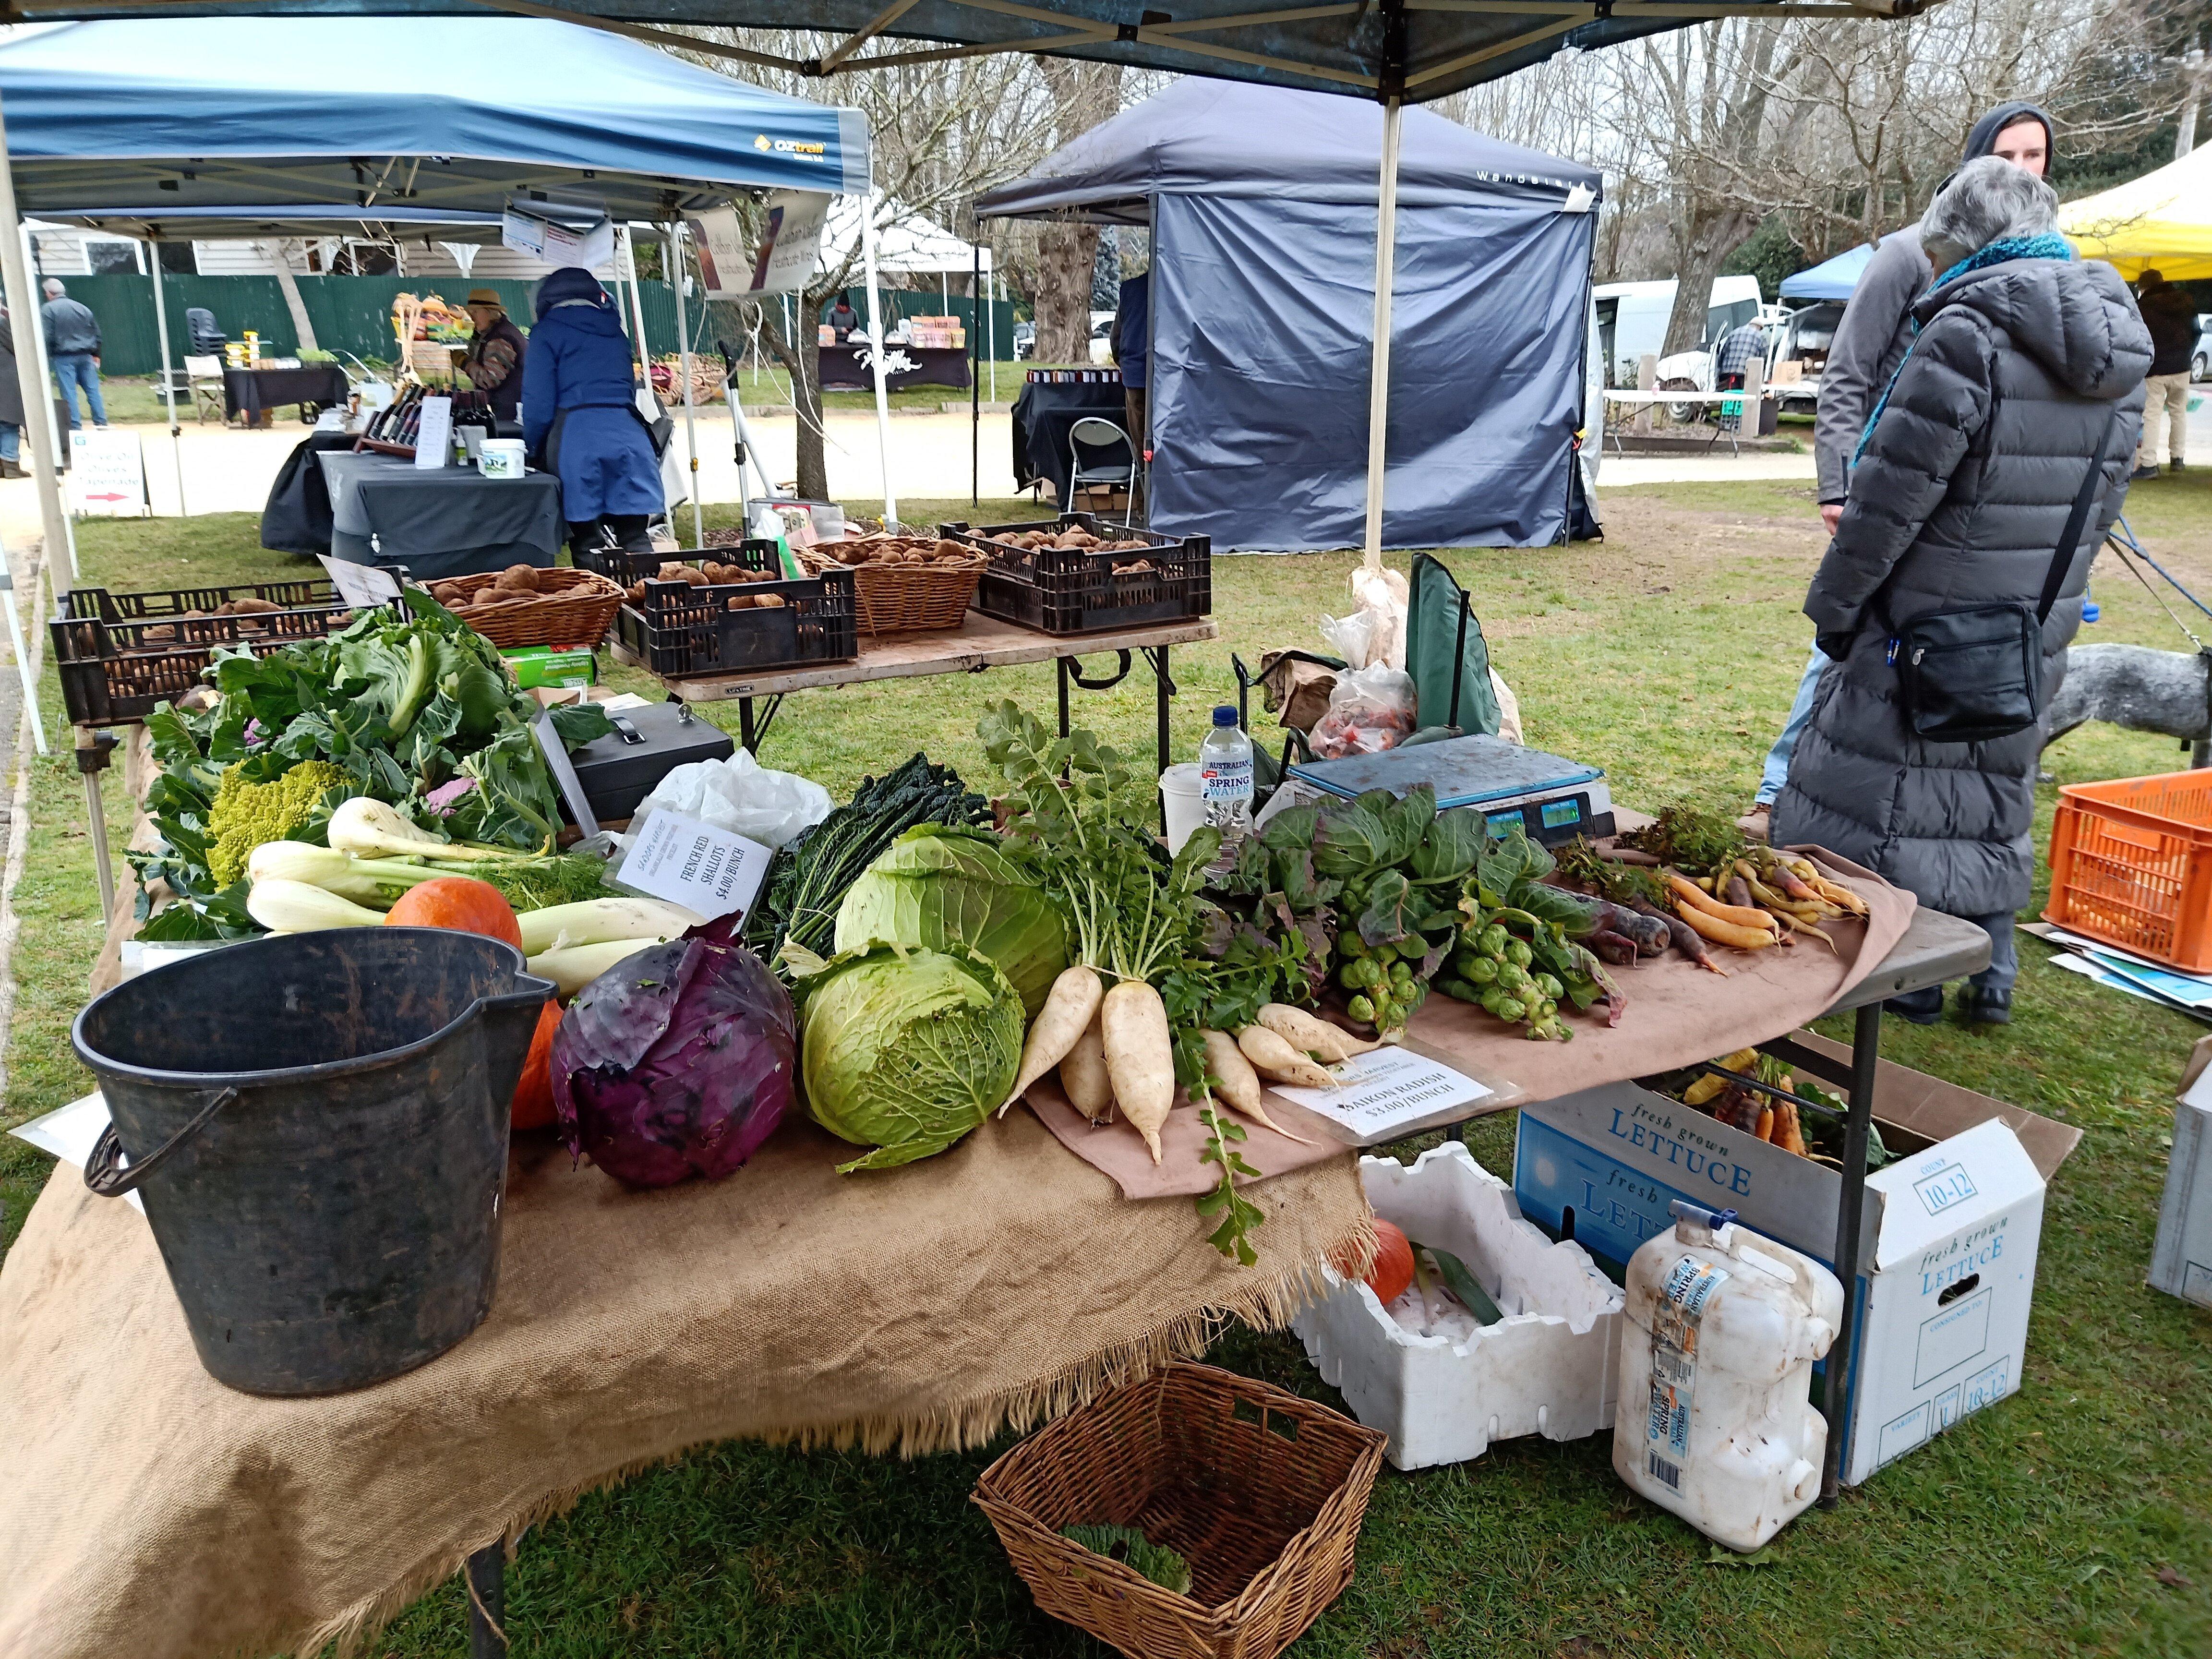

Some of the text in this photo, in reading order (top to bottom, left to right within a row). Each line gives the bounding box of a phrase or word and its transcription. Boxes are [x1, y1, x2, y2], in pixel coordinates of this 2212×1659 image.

[1477, 170, 1572, 189] Wanderer
[1209, 759, 1249, 769] AUSTRALIAN
[1209, 776, 1249, 787] SPRING
[1210, 784, 1249, 796] WATER
[680, 836, 709, 882] FRENCH RED
[701, 845, 725, 885] SHALLOTS
[715, 847, 745, 900] $4.00/BUNCH
[1346, 1089, 1397, 1111] DAIKON
[1395, 1072, 1446, 1094] RADISH
[1365, 1083, 1455, 1118] $3.00/BUNCH
[1631, 1103, 1729, 1157] fresh grown
[1608, 1107, 1751, 1197] LETTUCE
[1920, 1157, 1946, 1175] COUNT
[1606, 1169, 1658, 1203] fresh
[1925, 1173, 1972, 1209] 10-12
[1918, 1216, 2008, 1275] fresh grown
[1922, 1235, 2003, 1295] LETTUCE
[1673, 1266, 1700, 1304] SPRING
[1690, 1274, 1716, 1312] AUSTRALIAN
[1651, 1391, 1661, 1430] WATER
[1968, 1373, 2005, 1410] 10-12
[1659, 1395, 1670, 1435] SPRING
[1676, 1403, 1686, 1443] AUSTRALIAN
